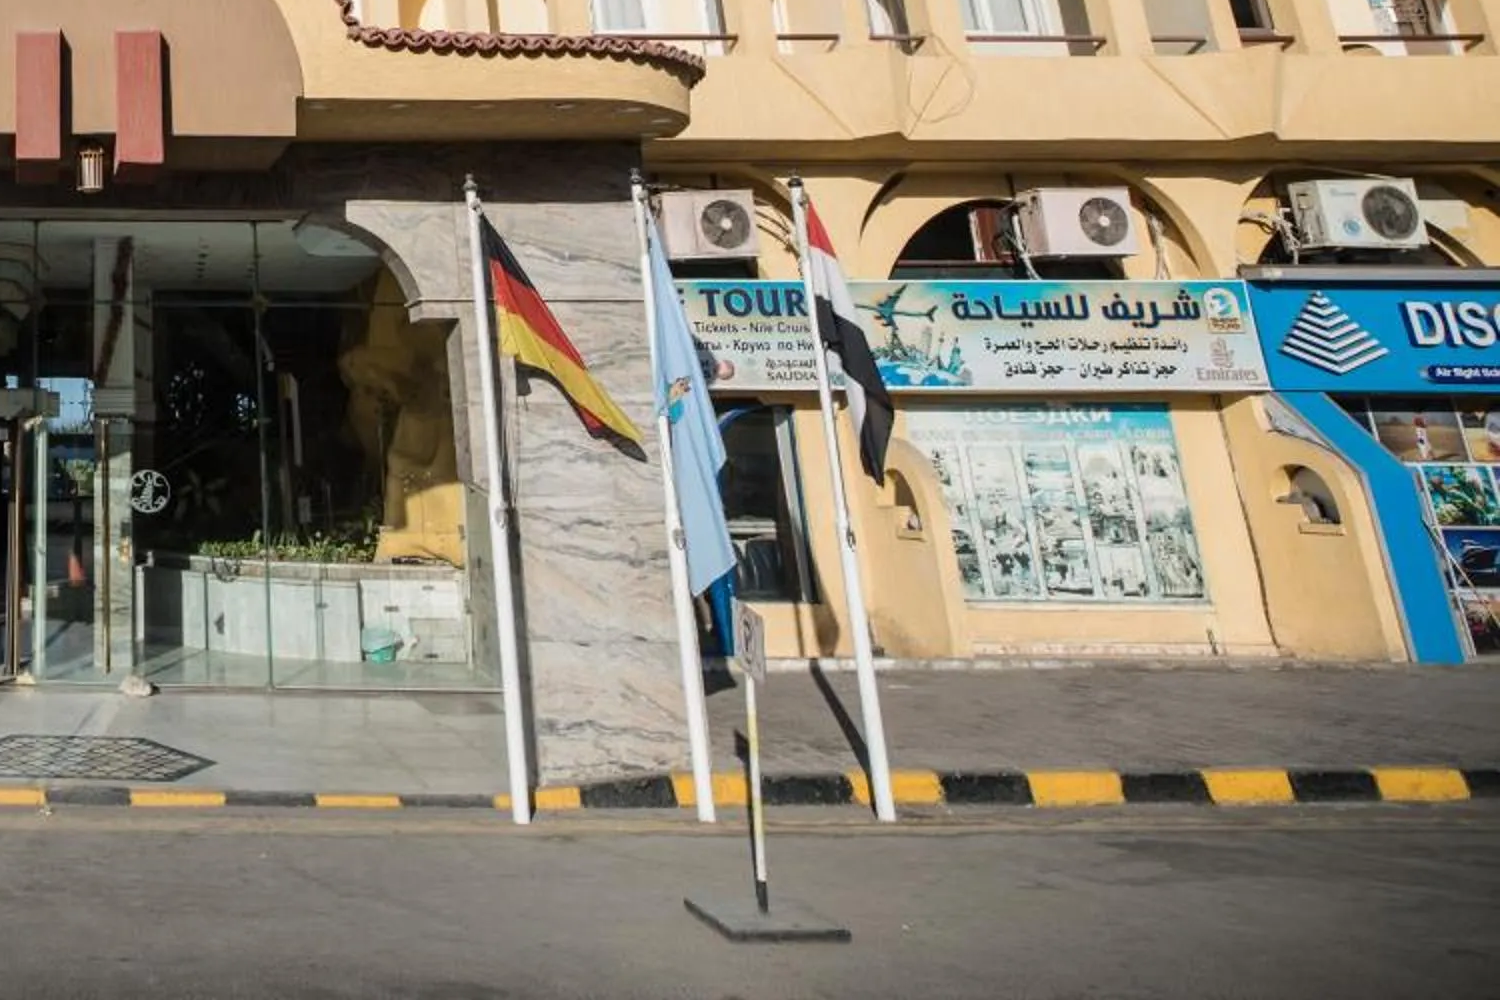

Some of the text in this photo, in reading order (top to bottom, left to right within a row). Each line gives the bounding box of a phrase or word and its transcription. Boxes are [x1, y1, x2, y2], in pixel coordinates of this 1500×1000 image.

[952, 288, 1201, 328] شريف للسياحة
[694, 321, 739, 334] Tickets
[1196, 367, 1259, 381] Emirates
